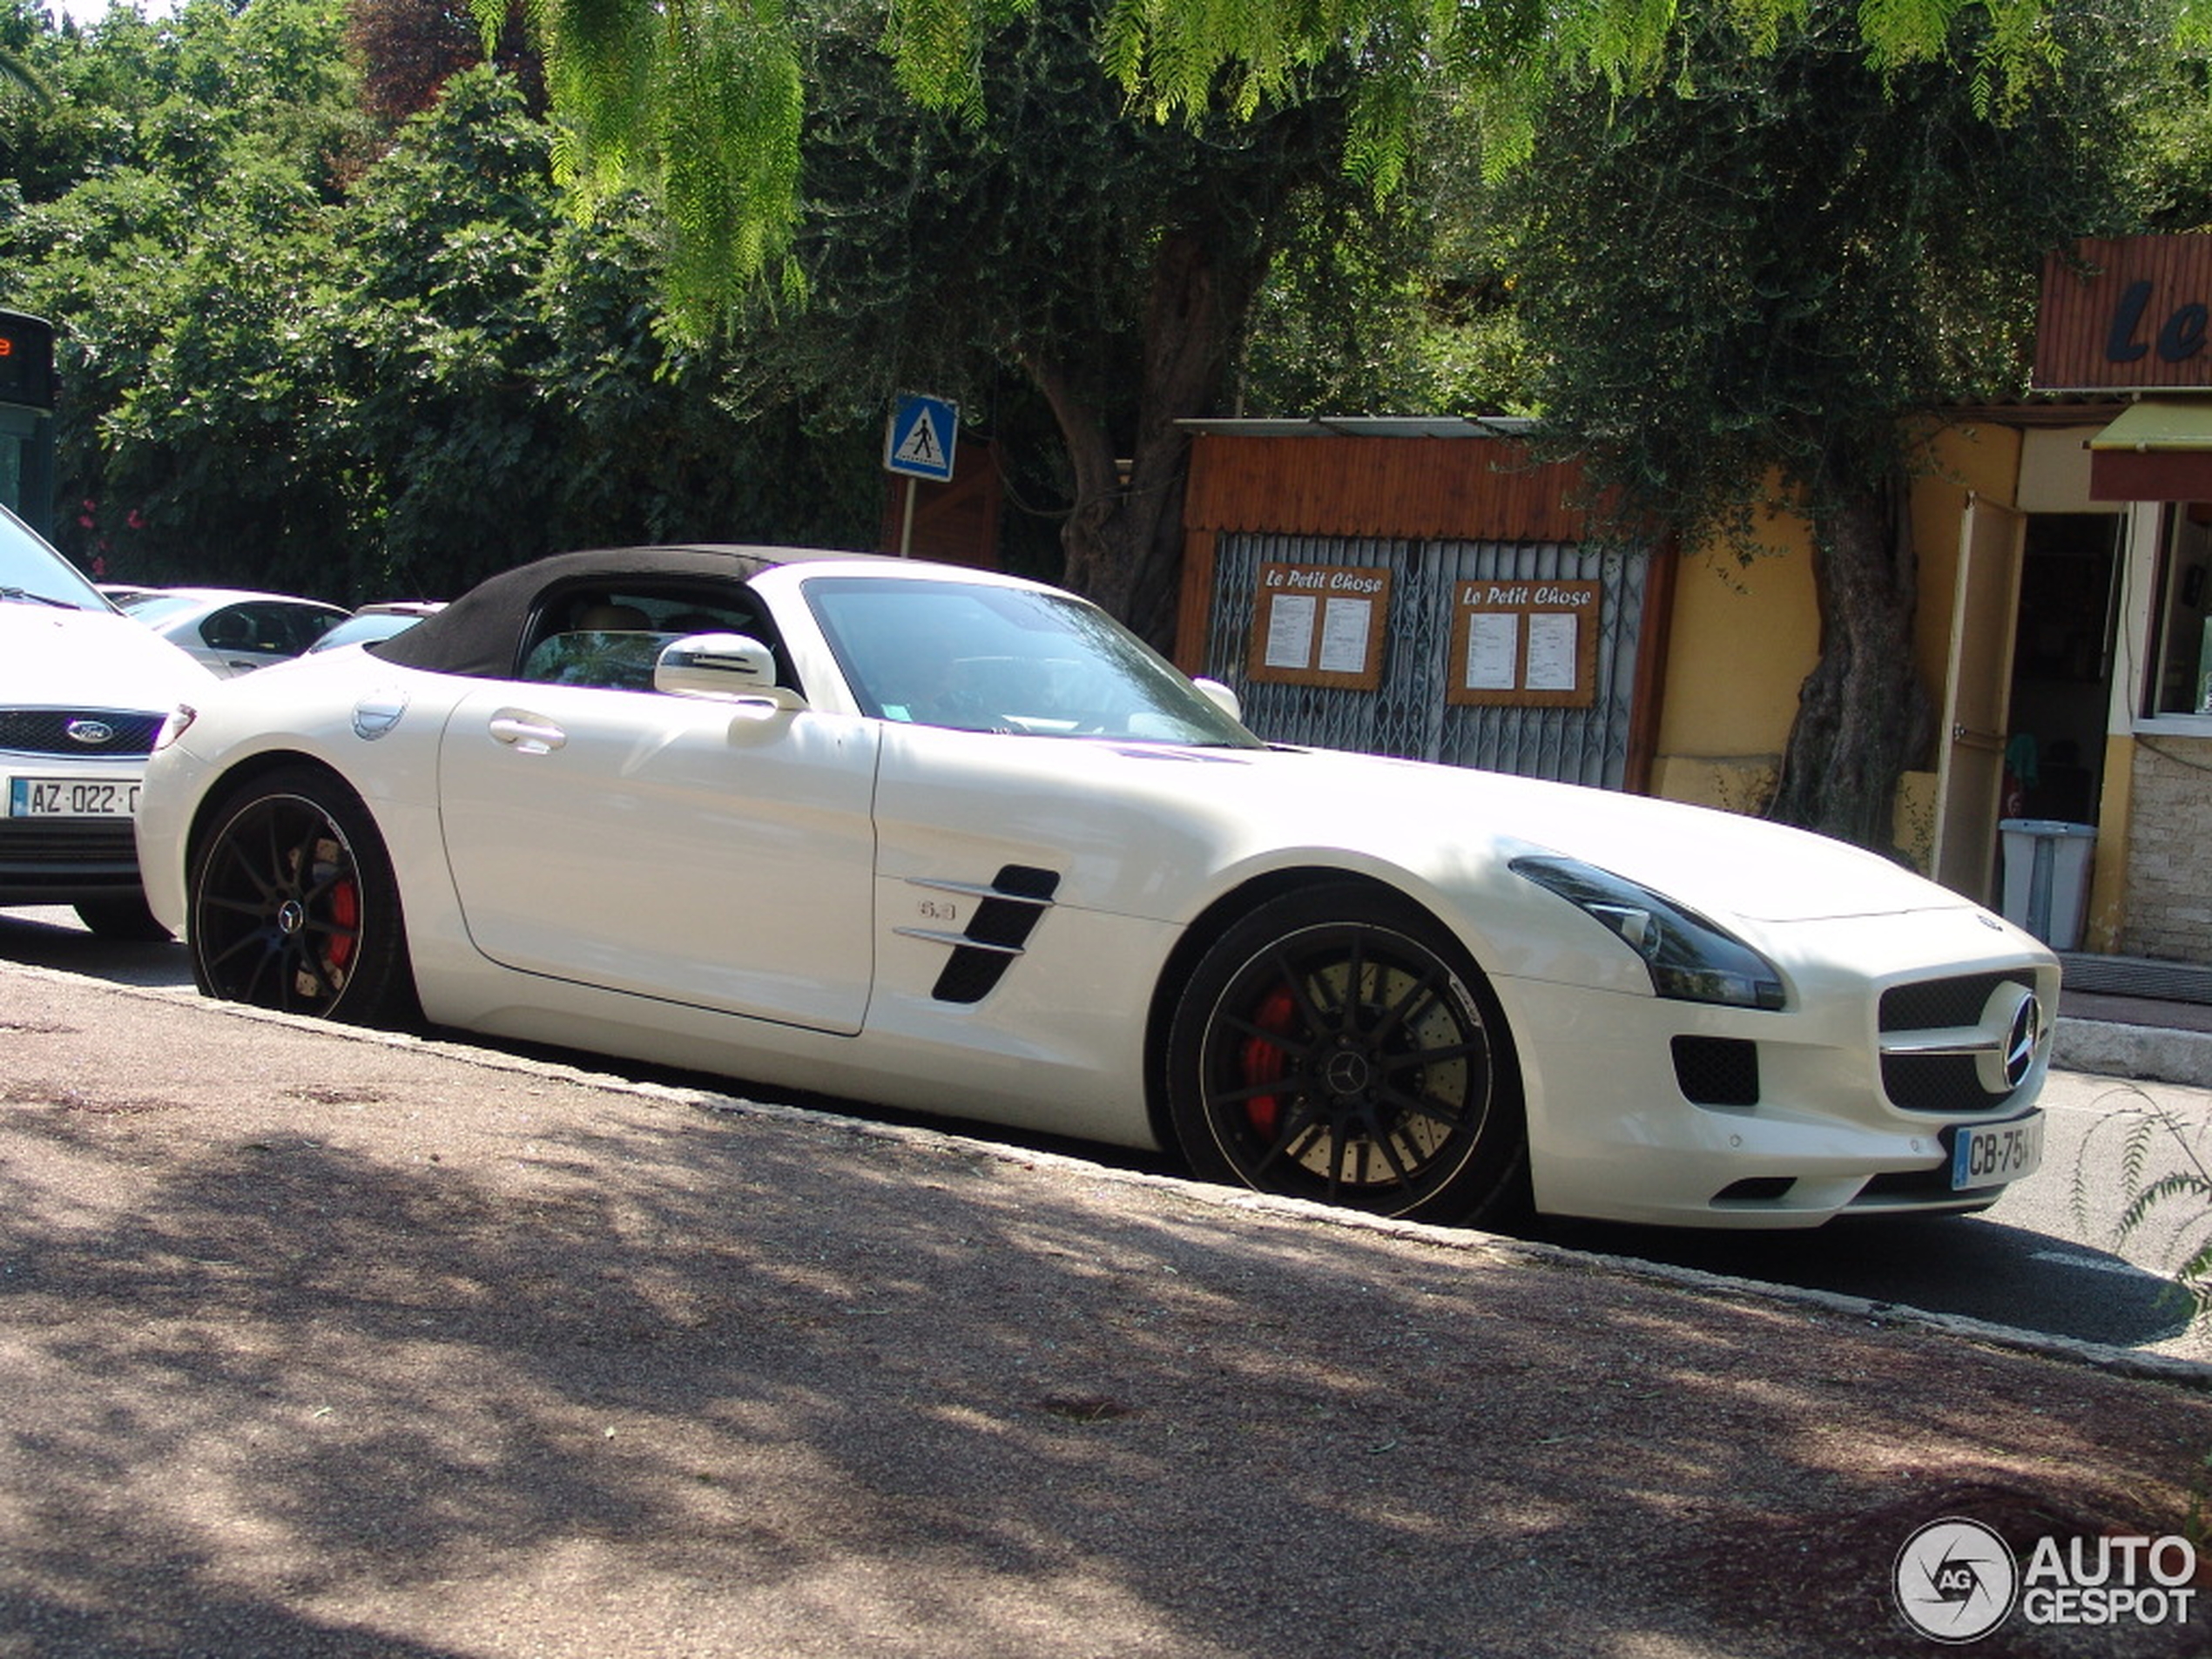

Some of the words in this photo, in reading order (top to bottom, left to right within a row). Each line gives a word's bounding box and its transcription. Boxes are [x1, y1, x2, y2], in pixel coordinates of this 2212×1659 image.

[2105, 280, 2210, 363] Le
[1265, 570, 1285, 587] Le
[1287, 570, 1326, 589] Petit
[1330, 571, 1384, 594] Chose
[1462, 586, 1481, 605] Le
[1486, 587, 1529, 605] Petit
[1534, 586, 1592, 607] Chose
